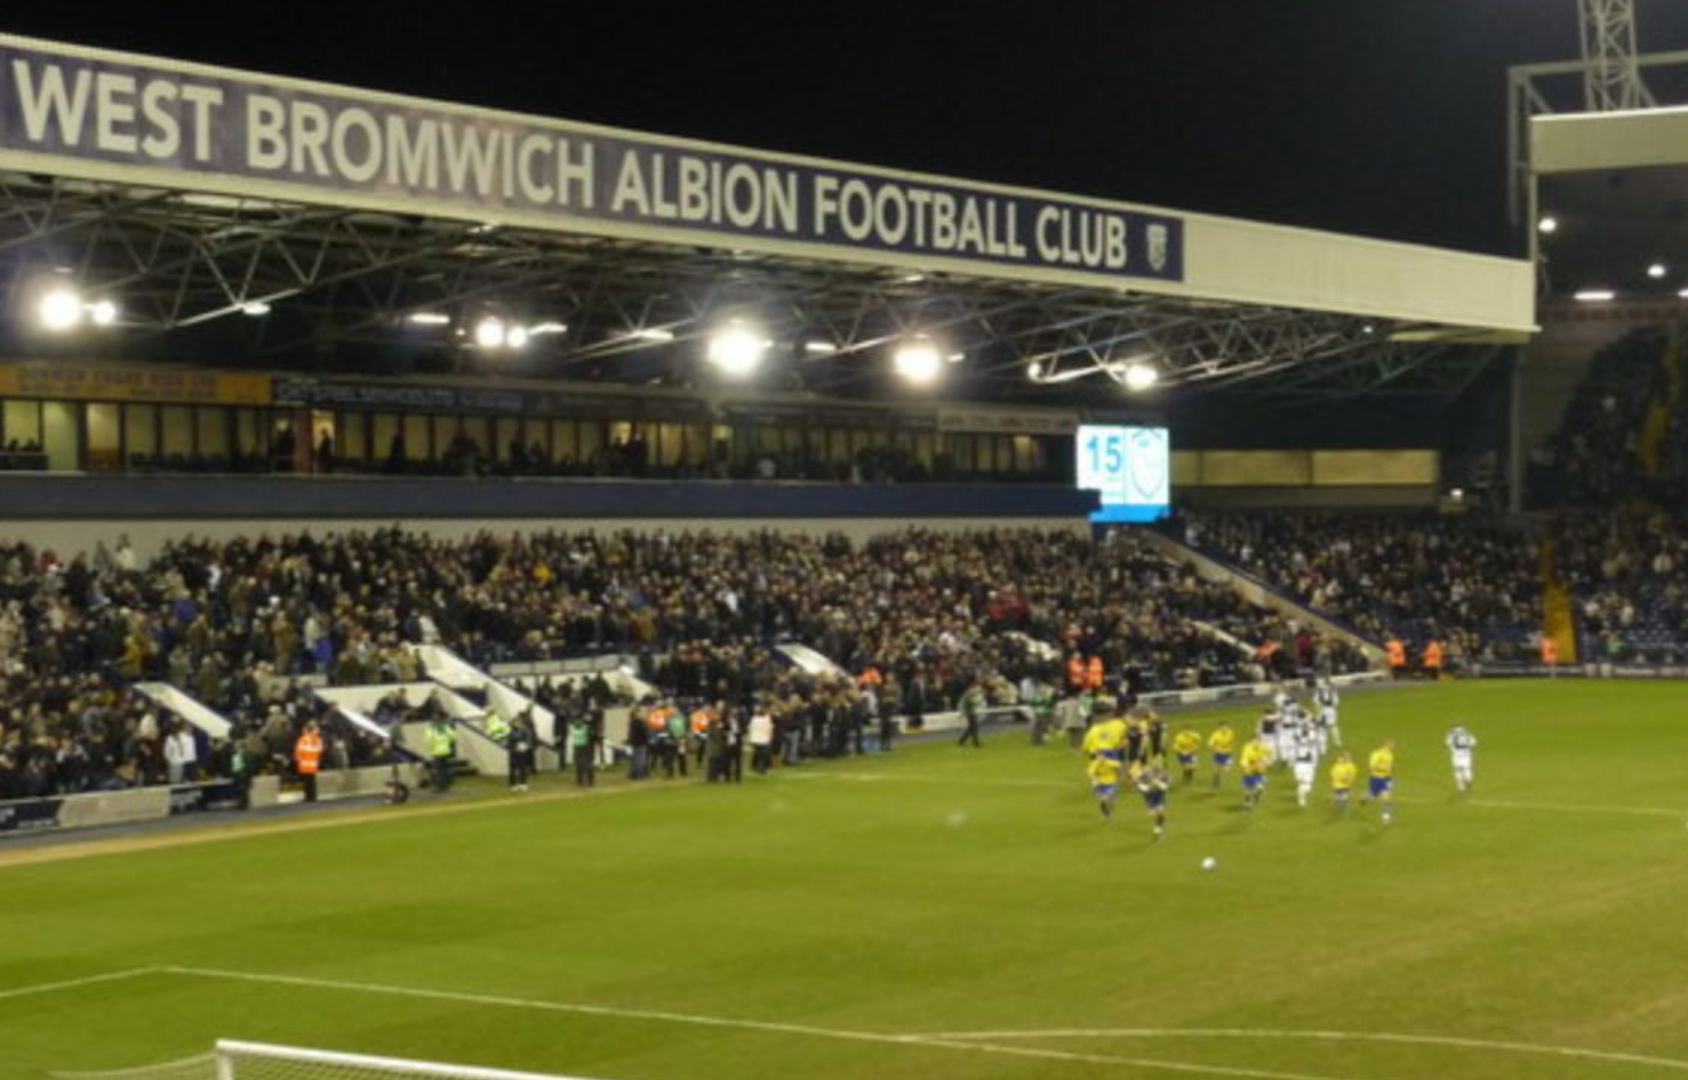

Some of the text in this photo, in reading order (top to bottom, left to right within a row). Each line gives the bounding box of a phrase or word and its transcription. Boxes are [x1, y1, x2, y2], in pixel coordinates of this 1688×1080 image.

[13, 59, 1127, 269] WEST BROMWICH ALBION FOOTBALL CLUB
[1086, 436, 1122, 473] 15
